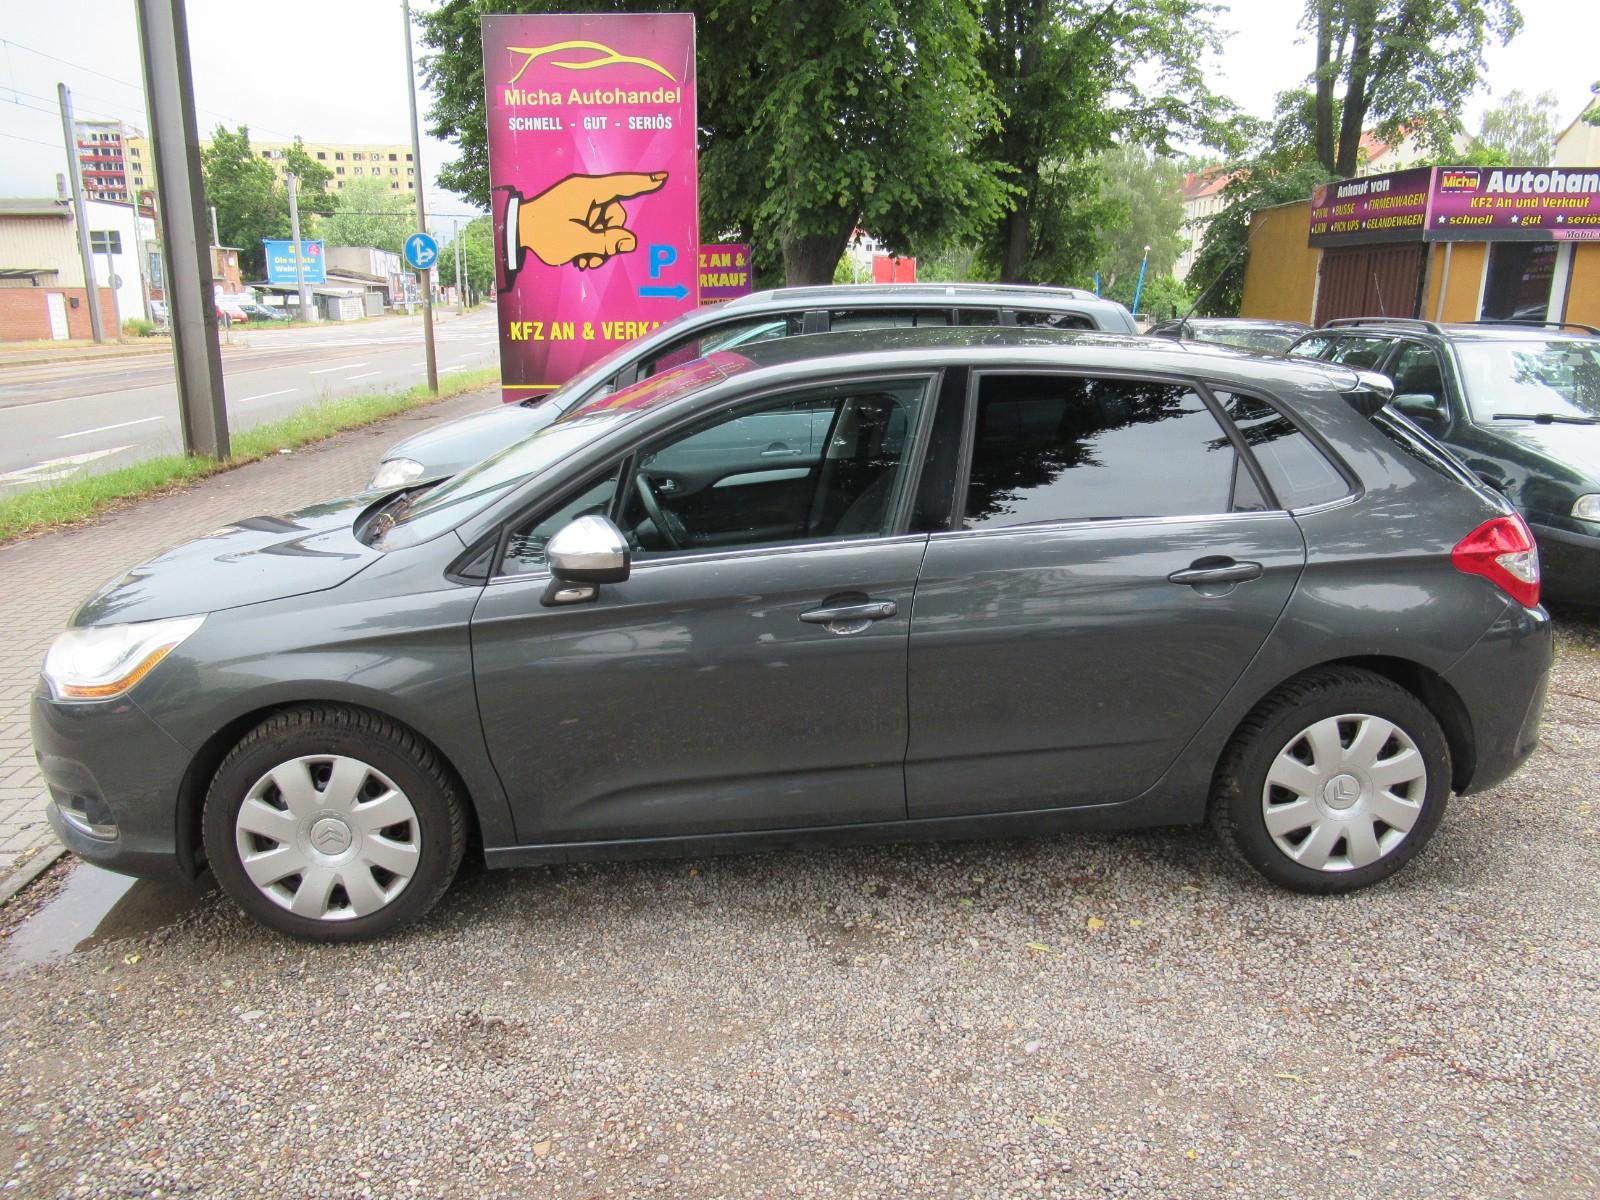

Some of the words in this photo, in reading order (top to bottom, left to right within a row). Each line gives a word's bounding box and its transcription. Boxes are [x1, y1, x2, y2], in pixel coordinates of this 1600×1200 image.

[504, 88, 562, 106] Micha
[567, 87, 681, 105] Autohandel
[508, 117, 563, 131] SCHNELL
[583, 117, 608, 130] GUT
[628, 114, 673, 130] SERIÖS
[1337, 181, 1369, 198] Ankauf
[1370, 179, 1390, 193] von
[1442, 175, 1478, 188] Micha
[1487, 170, 1600, 193] Autohan
[1368, 193, 1426, 210] FIRMENWAGEN
[1470, 197, 1494, 208] KFZ
[1496, 197, 1512, 208] An
[1515, 197, 1539, 208] und
[1542, 197, 1590, 208] Verkauf
[1315, 208, 1329, 219] PKW
[1335, 203, 1356, 216] BUSSE
[1333, 220, 1346, 232] PICK
[1347, 219, 1360, 231] UPS
[1449, 214, 1494, 225] schnell
[1520, 215, 1542, 227] gut
[1314, 223, 1328, 233] LKW
[1565, 231, 1596, 239] Mobil:
[649, 244, 677, 279] P
[710, 253, 731, 267] AN
[736, 252, 745, 267] &
[699, 272, 747, 287] RKAUF
[510, 321, 545, 341] KFZ
[550, 321, 575, 341] AN
[581, 321, 596, 341] &
[601, 321, 669, 341] VERK
